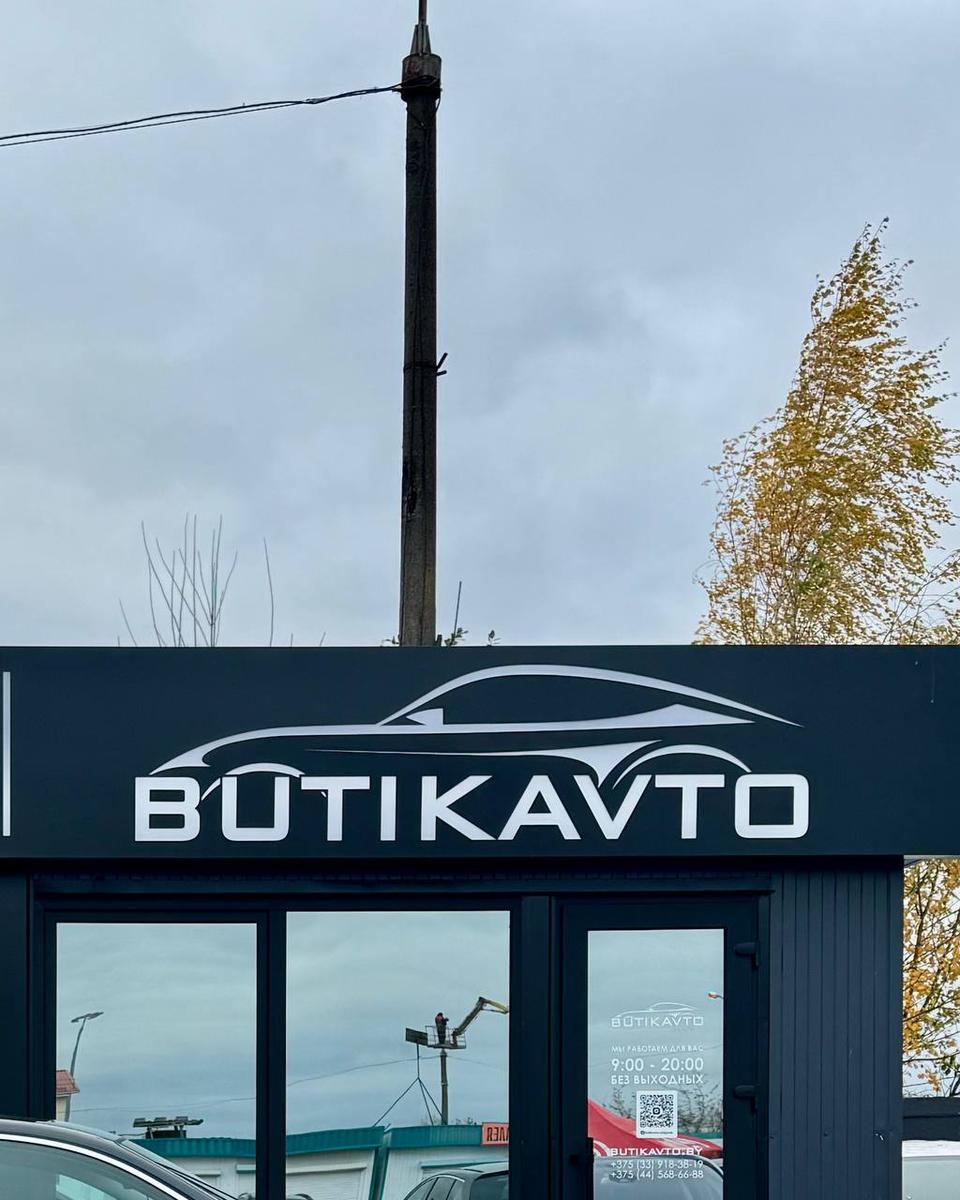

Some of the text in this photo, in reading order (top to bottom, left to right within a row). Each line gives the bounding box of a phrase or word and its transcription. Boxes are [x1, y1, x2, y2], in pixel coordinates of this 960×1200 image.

[134, 773, 810, 842] BUTIKAVTO
[611, 1016, 704, 1027] BUTIKAVTO
[611, 1045, 625, 1053] МЫ
[611, 1058, 644, 1071] 9:00
[661, 1057, 704, 1071] 20:00
[611, 1074, 704, 1085] БЕЗ ВЫХОДНЫХ
[610, 1147, 703, 1156] BUTIKAVTO.BY
[610, 1159, 704, 1170] +375 (33) 918-38-19
[610, 1169, 704, 1180] +375 (44) 568-66-88
